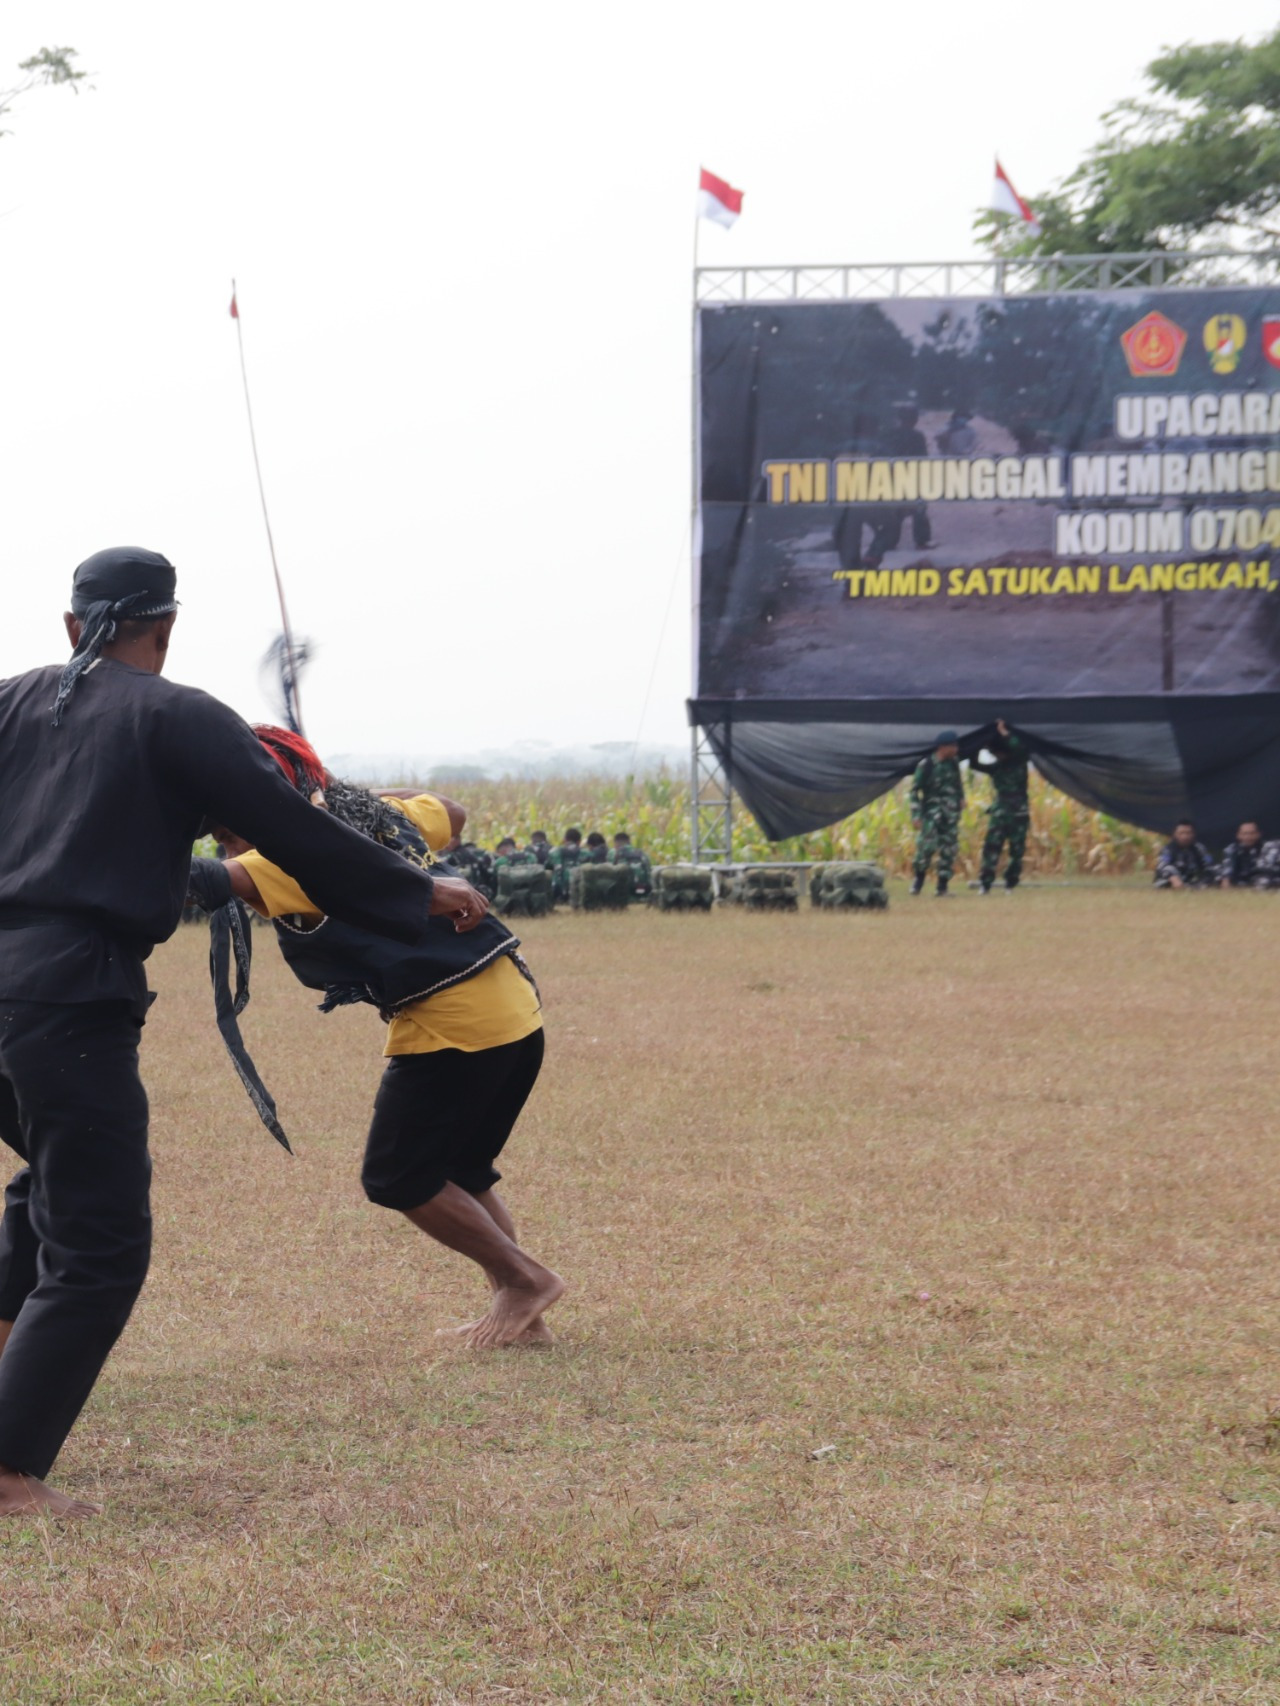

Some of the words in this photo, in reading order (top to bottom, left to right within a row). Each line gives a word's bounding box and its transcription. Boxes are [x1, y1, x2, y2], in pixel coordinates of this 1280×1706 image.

[766, 461, 827, 504] TNI
[835, 456, 1066, 502] MANUNGGAL
[1055, 510, 1184, 556] KODIM
[1190, 507, 1280, 551] 0704
[946, 565, 1101, 597] SATUKAN
[1107, 560, 1279, 593] LANGKAH,
